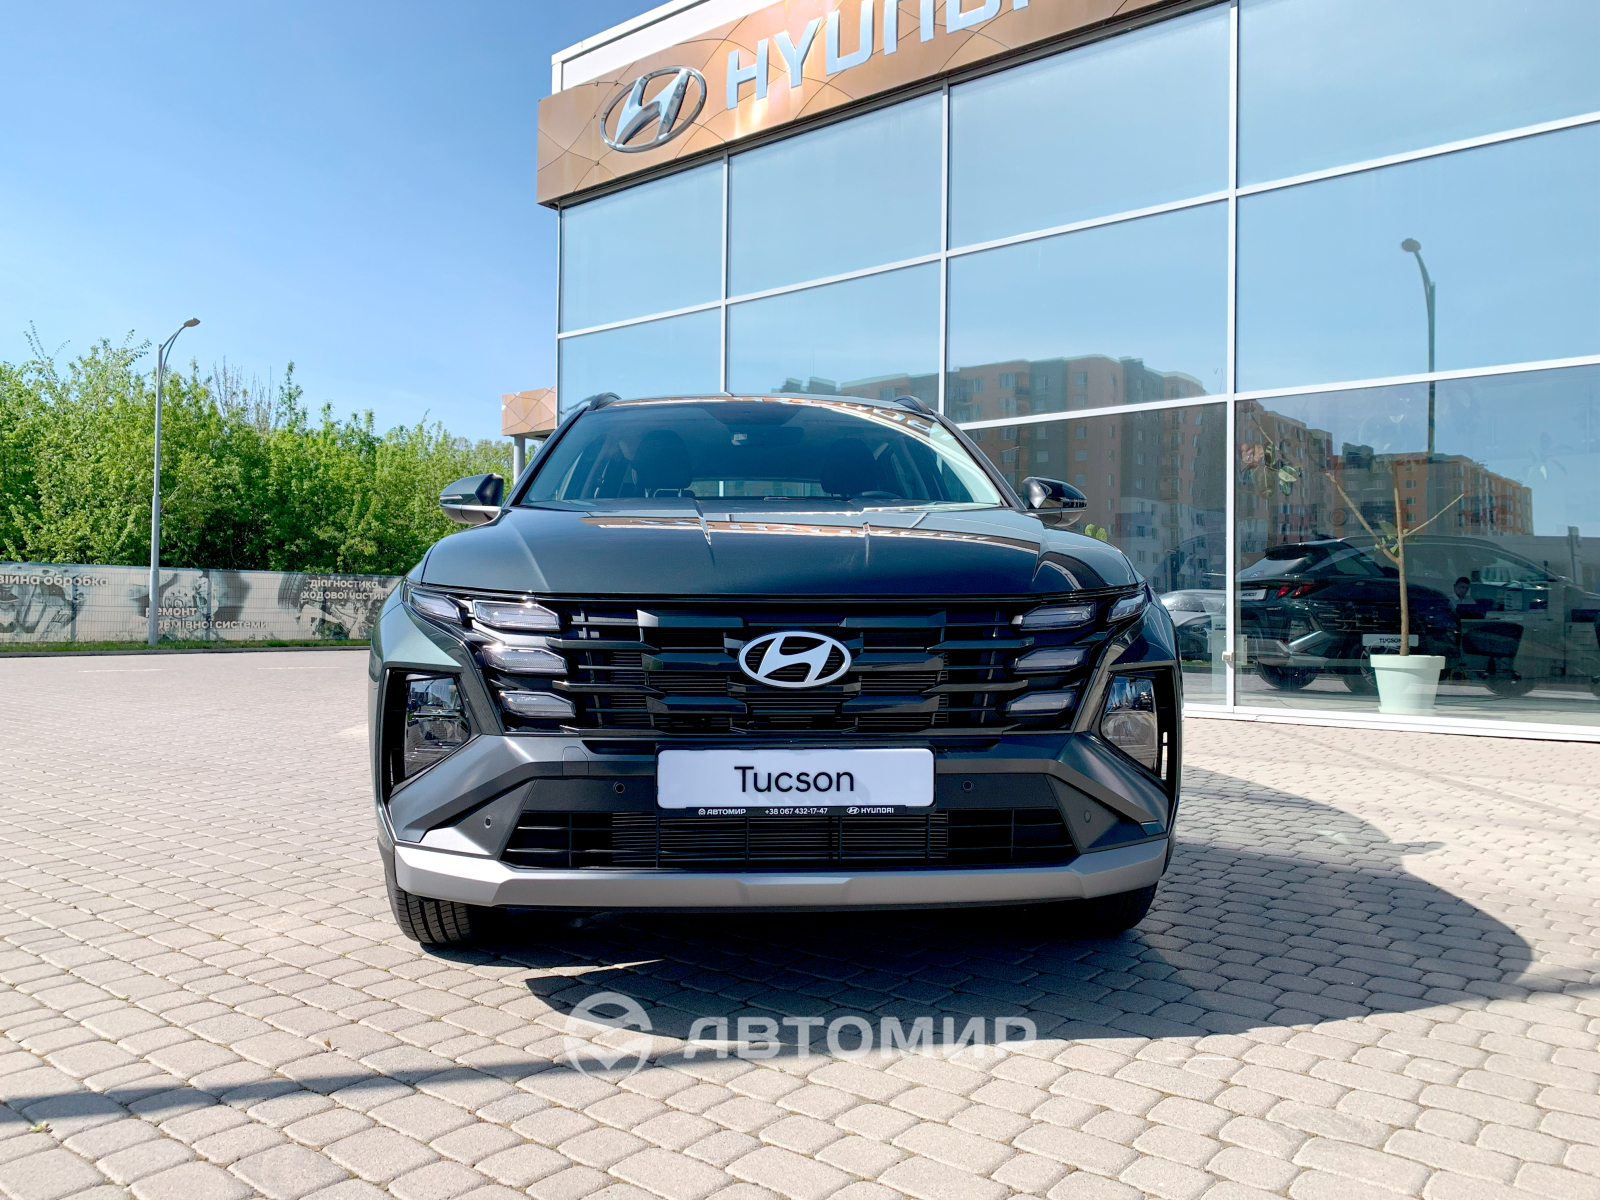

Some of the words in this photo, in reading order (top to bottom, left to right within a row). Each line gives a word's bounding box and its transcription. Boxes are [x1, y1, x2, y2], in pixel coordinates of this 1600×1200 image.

[43, 574, 109, 587] обробка
[309, 577, 378, 589] діагностика
[303, 589, 348, 601] ходової
[349, 593, 389, 601] частин
[214, 621, 268, 630] системи
[733, 765, 855, 793] Tucson
[706, 807, 747, 816] АВТОМИР
[764, 807, 779, 815] +38
[779, 807, 794, 815] 067
[794, 807, 829, 815] 432-17-47
